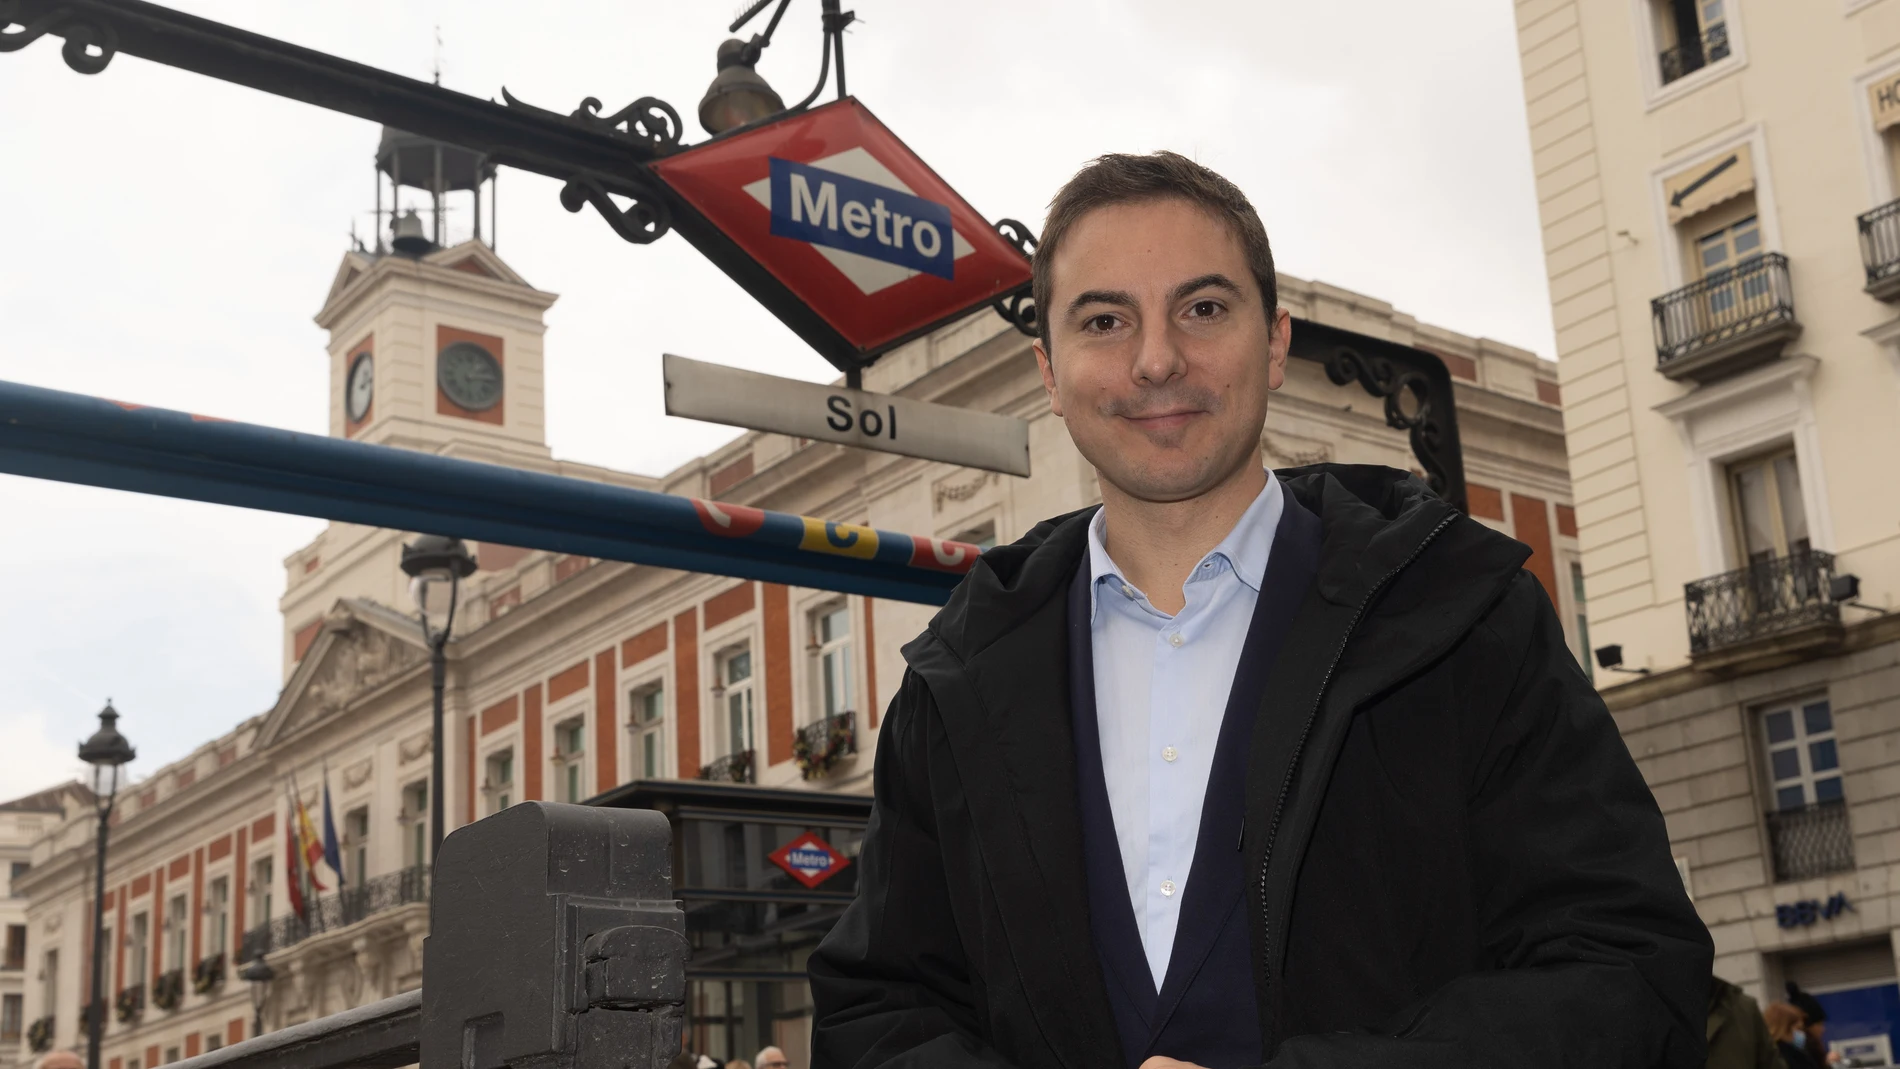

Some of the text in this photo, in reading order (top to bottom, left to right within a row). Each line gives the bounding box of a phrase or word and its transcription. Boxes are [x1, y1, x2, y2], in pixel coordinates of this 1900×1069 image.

[789, 172, 942, 259] Metro
[826, 395, 897, 440] Sol
[791, 851, 829, 868] Metro
[1776, 891, 1858, 930] BBVA
